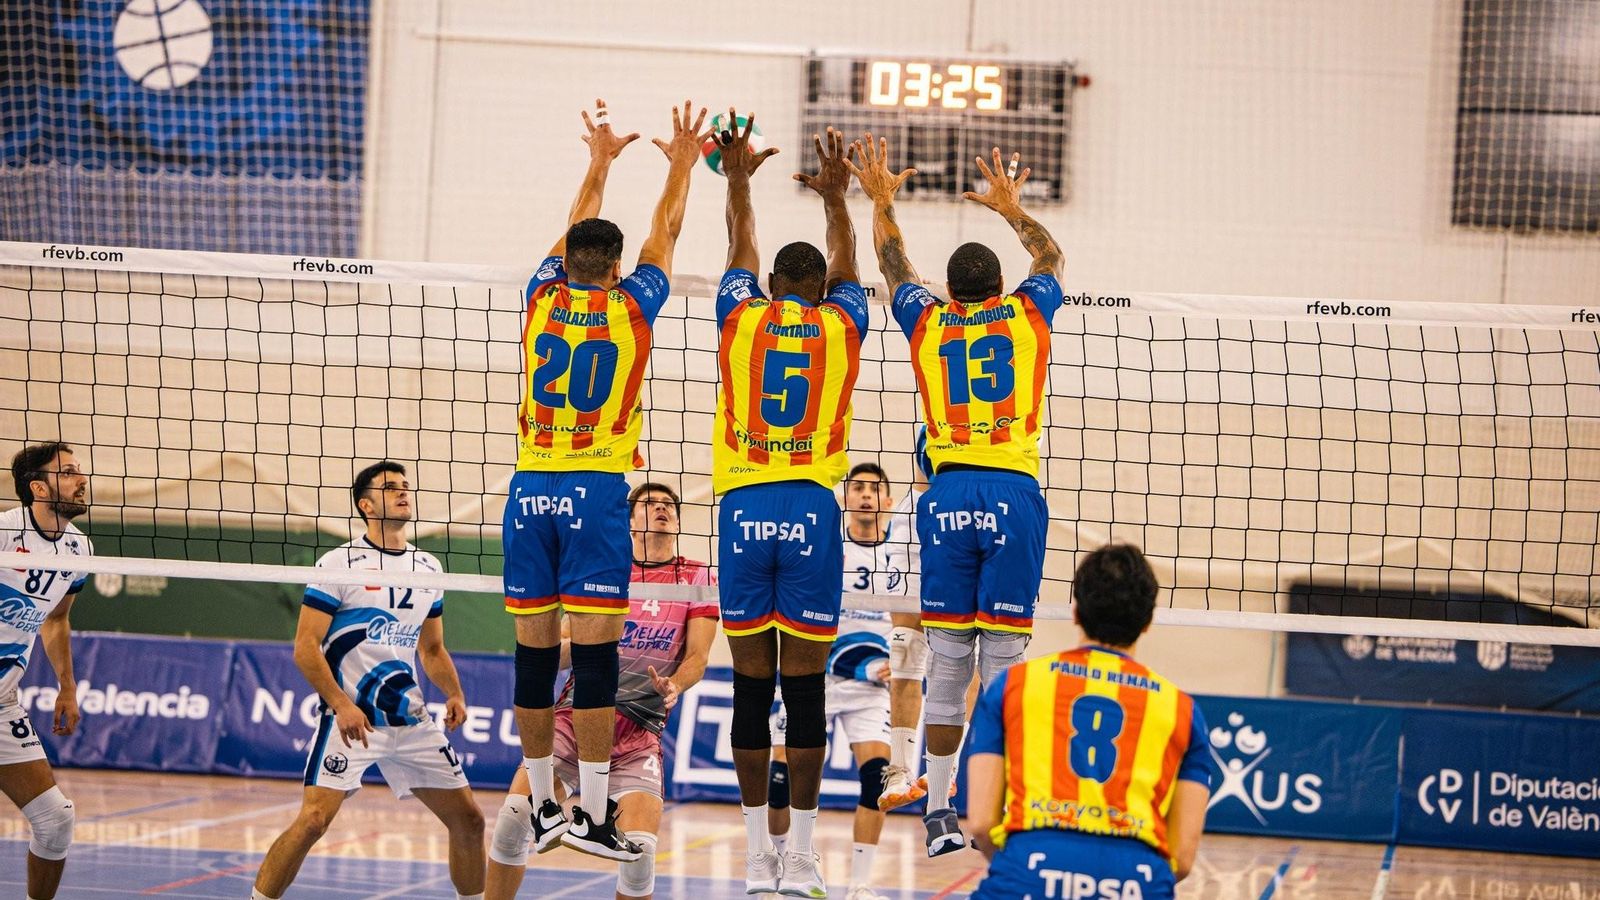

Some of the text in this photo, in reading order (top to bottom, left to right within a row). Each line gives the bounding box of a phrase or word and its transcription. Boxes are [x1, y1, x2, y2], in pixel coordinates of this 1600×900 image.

[869, 61, 1002, 110] 03:25
[41, 245, 124, 263] rfevb.com
[292, 258, 374, 275] rfevb.com
[1062, 292, 1131, 308] evb.com
[1306, 301, 1392, 317] rfevb.com
[550, 306, 609, 327] CALAZANS
[938, 303, 1017, 327] PERNAMBUCO
[764, 321, 821, 338] FURTADO
[532, 332, 619, 413] 20
[938, 333, 1016, 405] 13
[760, 348, 811, 428] 5
[736, 430, 813, 453] Hyundai
[518, 495, 574, 516] TIPSA
[739, 520, 806, 543] TIPSA
[935, 510, 998, 533] TIPSA
[24, 568, 58, 596] 87
[853, 566, 870, 590] 3
[388, 586, 414, 609] 12
[641, 599, 661, 617] 4
[1050, 661, 1161, 692] PAULO RENAN
[1069, 694, 1124, 784] 8
[642, 755, 661, 777] 4
[1490, 771, 1600, 802] Diputaci
[1488, 802, 1523, 828] de
[1038, 868, 1144, 900] TIPSA
